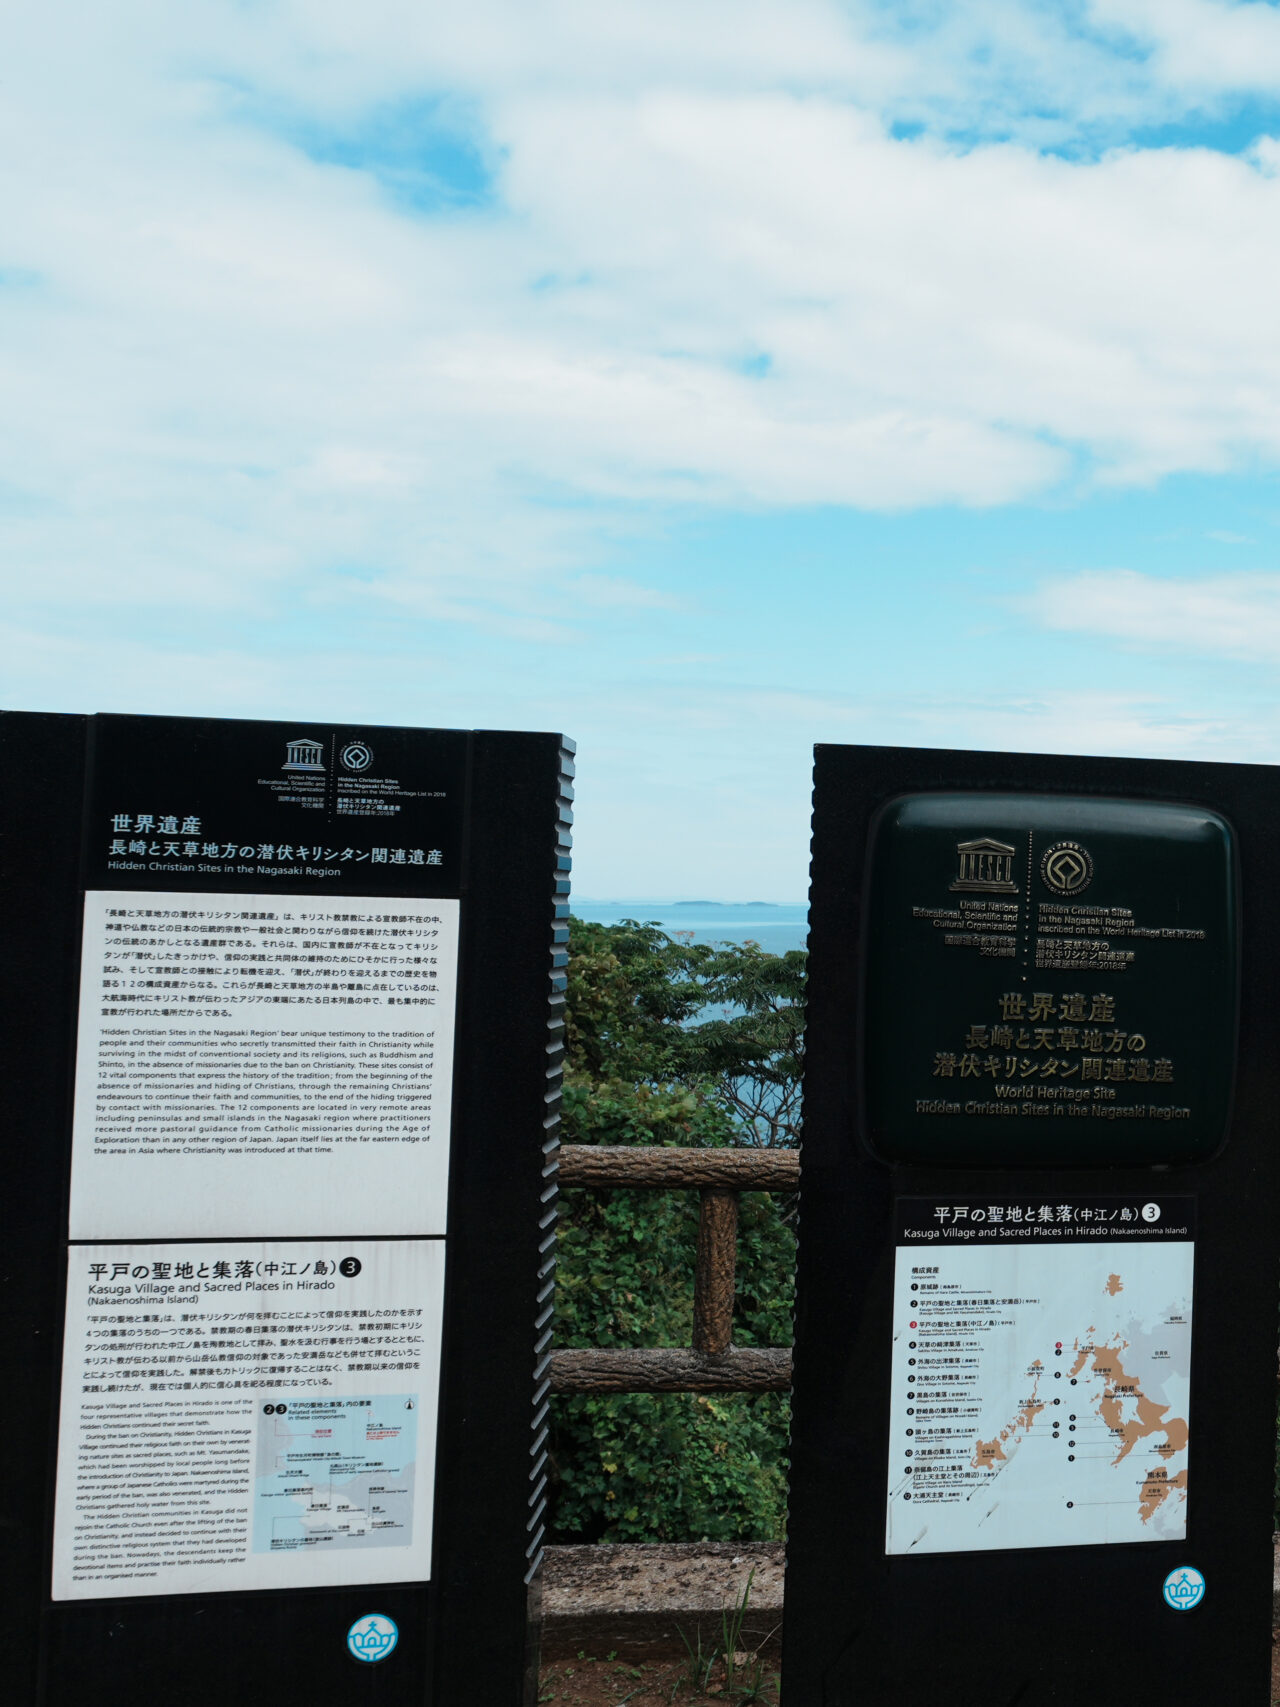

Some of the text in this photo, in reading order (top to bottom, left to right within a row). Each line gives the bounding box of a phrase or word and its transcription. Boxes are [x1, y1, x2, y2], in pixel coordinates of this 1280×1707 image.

[111, 815, 202, 835] 世界遺産
[110, 840, 443, 865] 長崎と天草地方の潜伏キリシタン関連遺産
[108, 861, 146, 870] Hidden
[149, 862, 195, 871] Christian
[198, 864, 222, 872] Sites
[238, 865, 255, 873] the
[257, 866, 303, 877] Nagasaki
[306, 867, 341, 878] Region
[960, 854, 1012, 881] UNESCO
[960, 902, 1019, 912] United Nations
[1040, 905, 1133, 917] Hidden Christian Sites
[913, 908, 1018, 922] Educational, Scientific and
[1065, 916, 1103, 926] Nagasaki
[1105, 918, 1135, 928] Region
[933, 920, 1018, 932] Cultural Organization
[1038, 925, 1074, 933] inscribed
[1103, 927, 1126, 935] World
[1128, 928, 1161, 937] Heritage
[1162, 929, 1176, 938] List
[1186, 930, 1206, 939] 2018
[1000, 992, 1115, 1022] 世界遺産
[967, 1025, 1146, 1053] 長崎と天草地方の
[934, 1053, 1173, 1082] 潜伏キリシタン関連遺産
[215, 1083, 241, 1091] hiding
[996, 1085, 1116, 1099] World Heritage Site
[917, 1100, 1191, 1120] Hidden Christian Sites in the Nagasaki Region
[96, 1115, 136, 1123] including
[904, 1229, 940, 1240] Kasuga
[943, 1228, 976, 1239] Village
[979, 1228, 997, 1237] and
[1000, 1228, 1031, 1236] Sacred
[1034, 1227, 1062, 1236] Places
[1076, 1226, 1108, 1235] Hirado
[89, 1280, 336, 1297] Kasuga Village and Sacred Places in Hirado
[88, 1295, 199, 1305] (Nakaenoshima Island)
